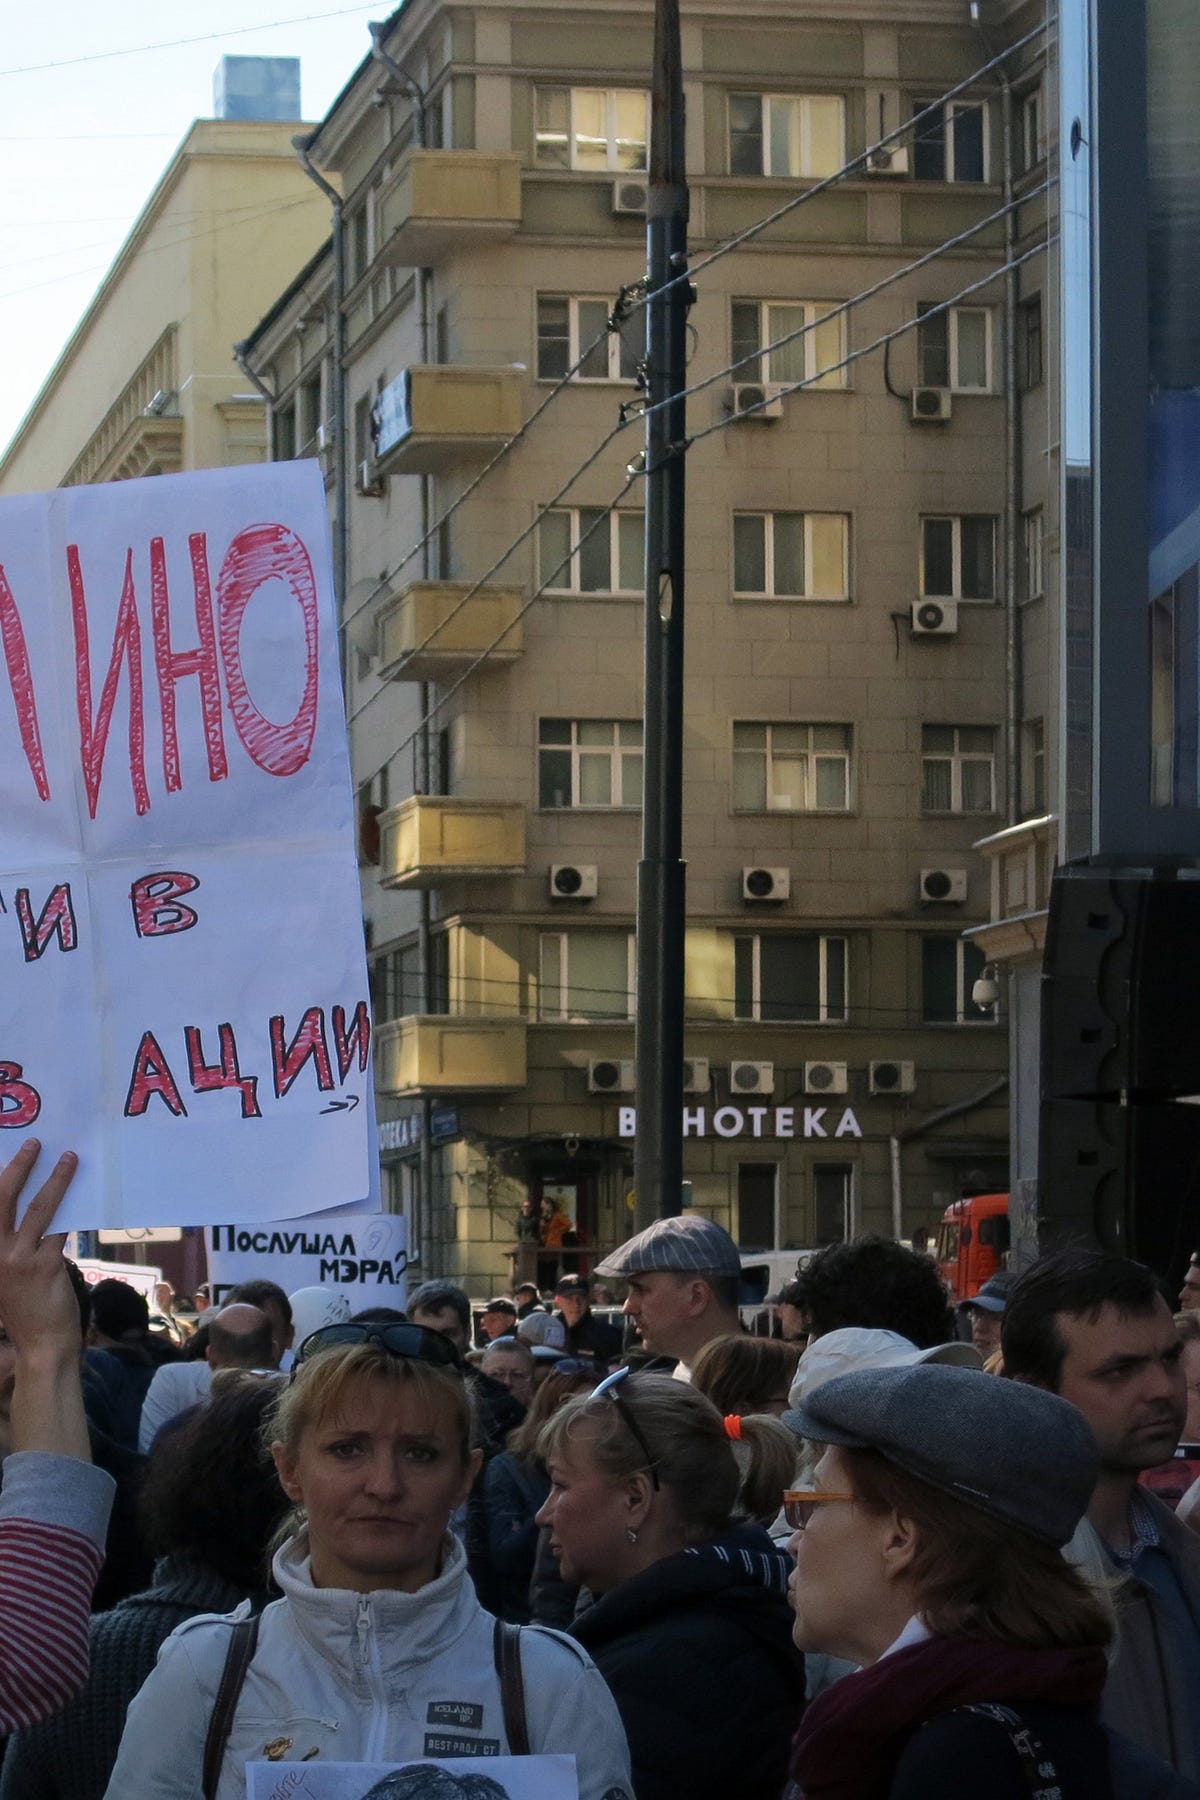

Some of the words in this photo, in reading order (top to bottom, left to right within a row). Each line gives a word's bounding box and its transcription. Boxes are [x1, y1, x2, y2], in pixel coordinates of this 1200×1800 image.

[618, 1105, 863, 1138] ВНОТЕКА
[319, 1250, 408, 1285] МЭРА?
[434, 1704, 474, 1715] ICELAND
[428, 1739, 452, 1751] BEST
[453, 1742, 497, 1756] PROJCT
